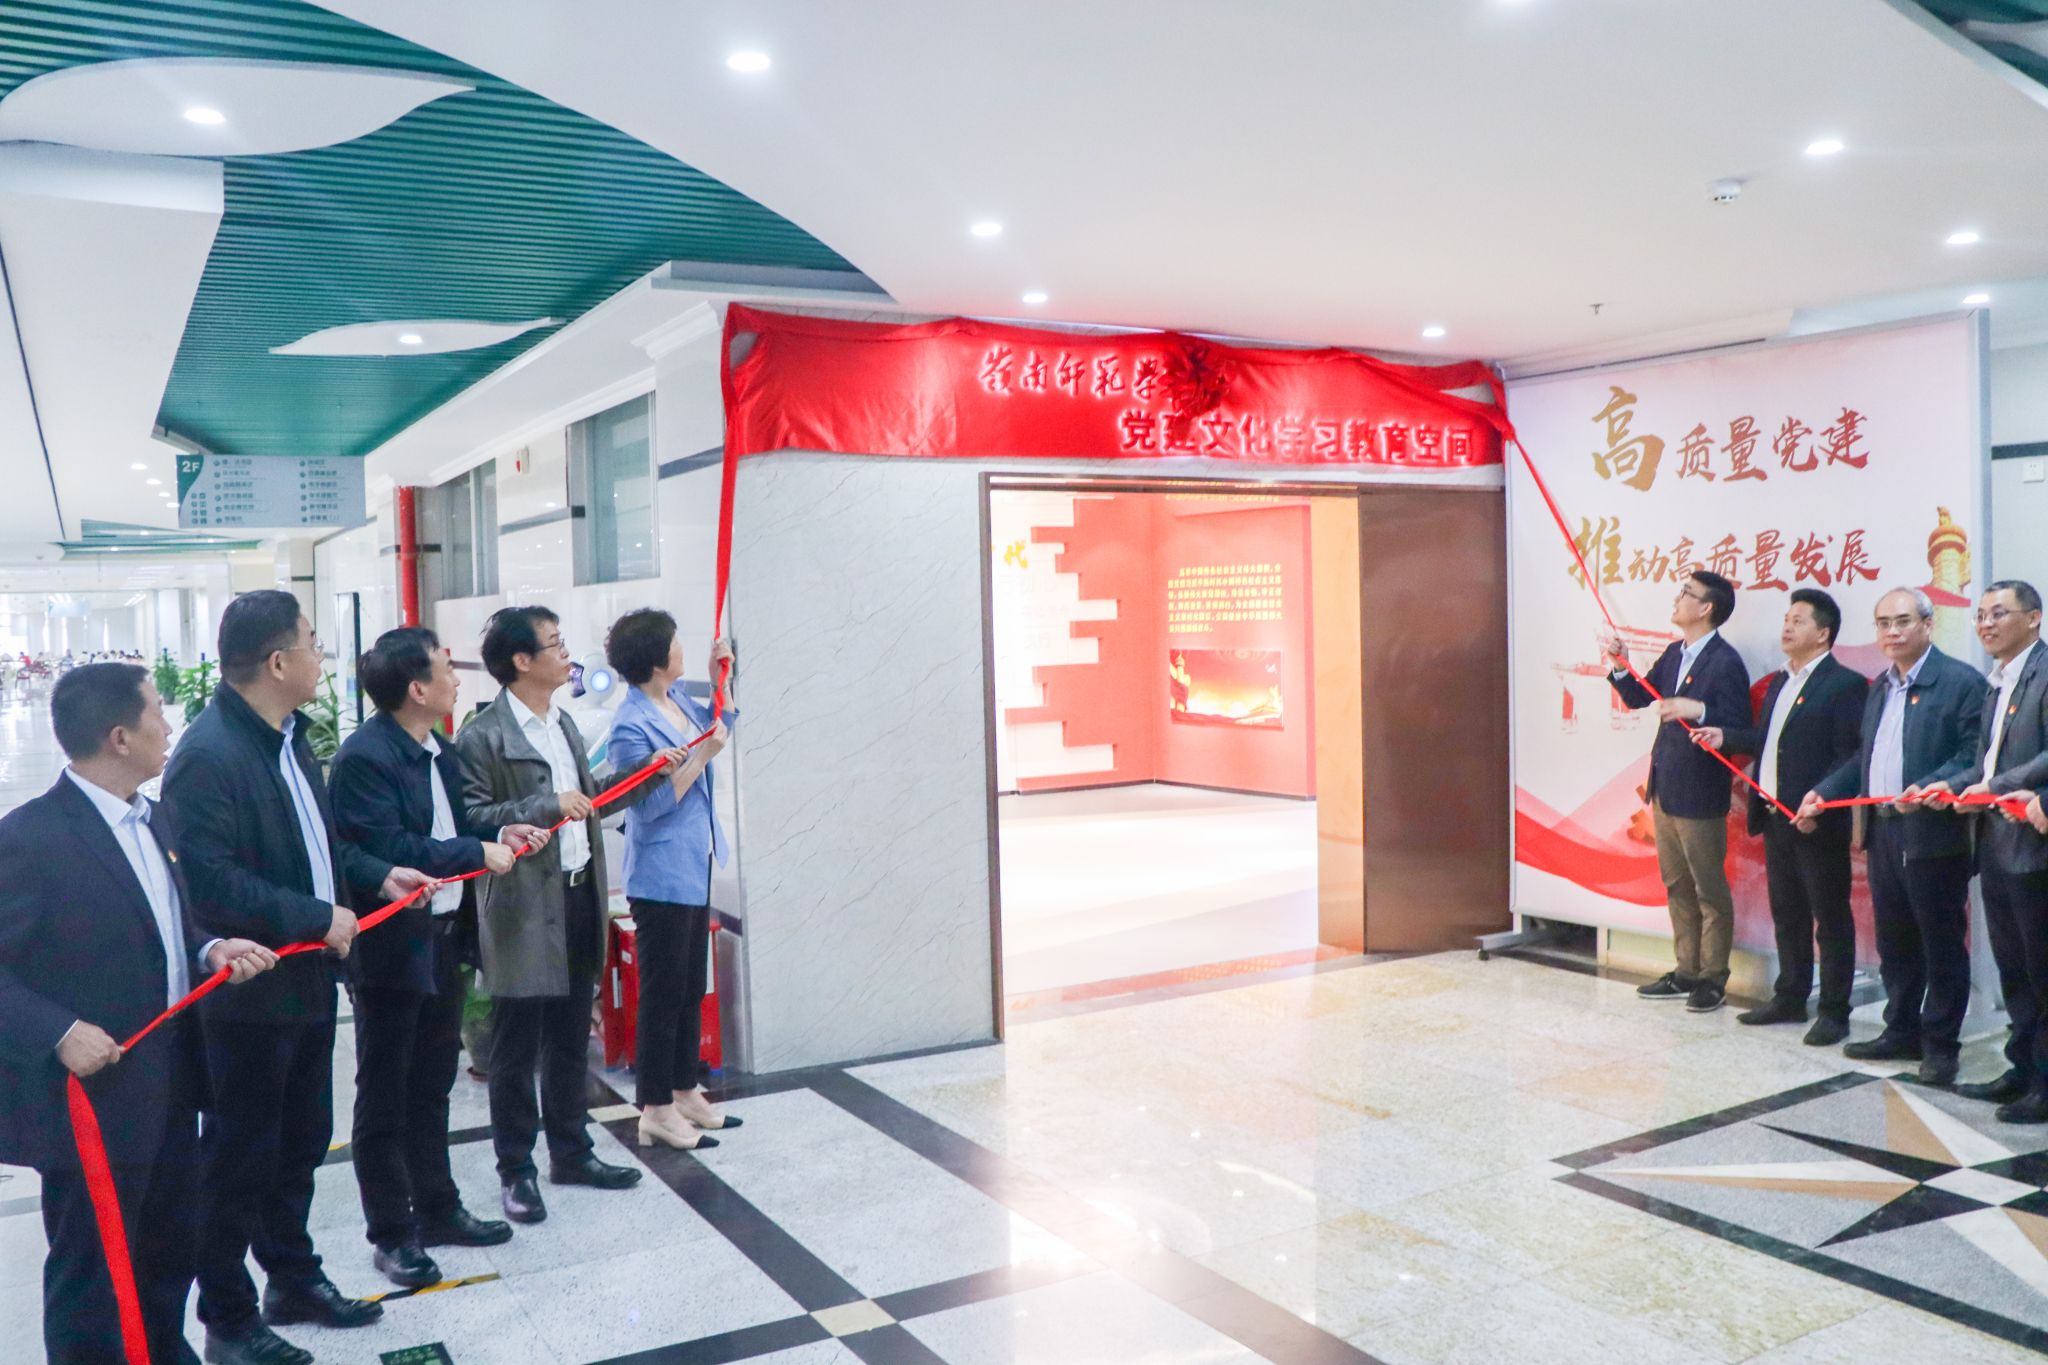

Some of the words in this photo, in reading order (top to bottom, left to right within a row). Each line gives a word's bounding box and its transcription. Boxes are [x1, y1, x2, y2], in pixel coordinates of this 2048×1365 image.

[182, 460, 200, 473] 2F
[1592, 385, 1870, 491] 高质量党建
[1568, 516, 1882, 592] 推动高质量发展
